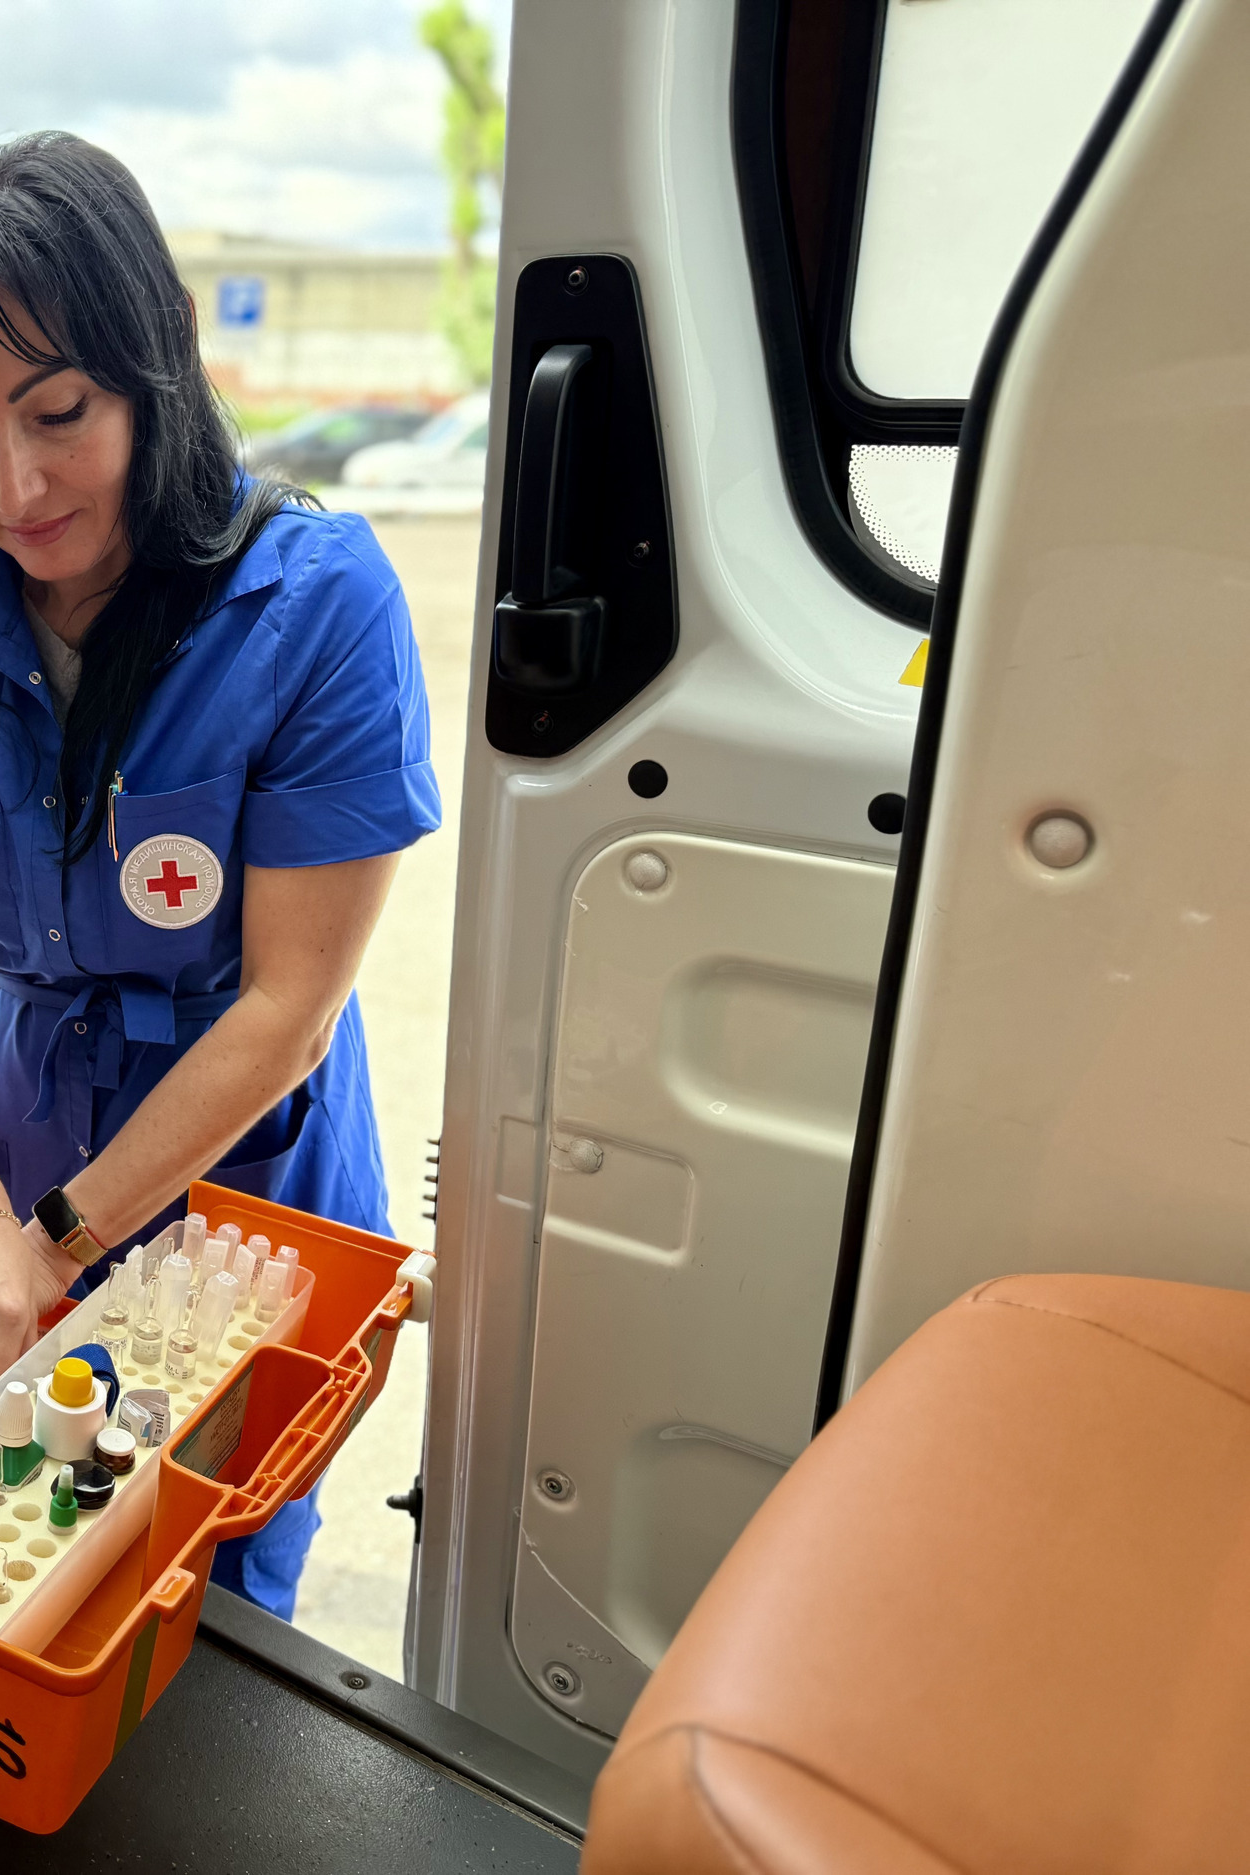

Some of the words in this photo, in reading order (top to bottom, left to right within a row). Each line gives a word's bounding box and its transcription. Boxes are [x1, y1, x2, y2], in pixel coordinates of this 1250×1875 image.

[130, 841, 205, 874] МЕДИЦИНСКАЯ
[128, 876, 155, 916] СКОРАЯ
[194, 864, 214, 909] ПОМОЩЬ
